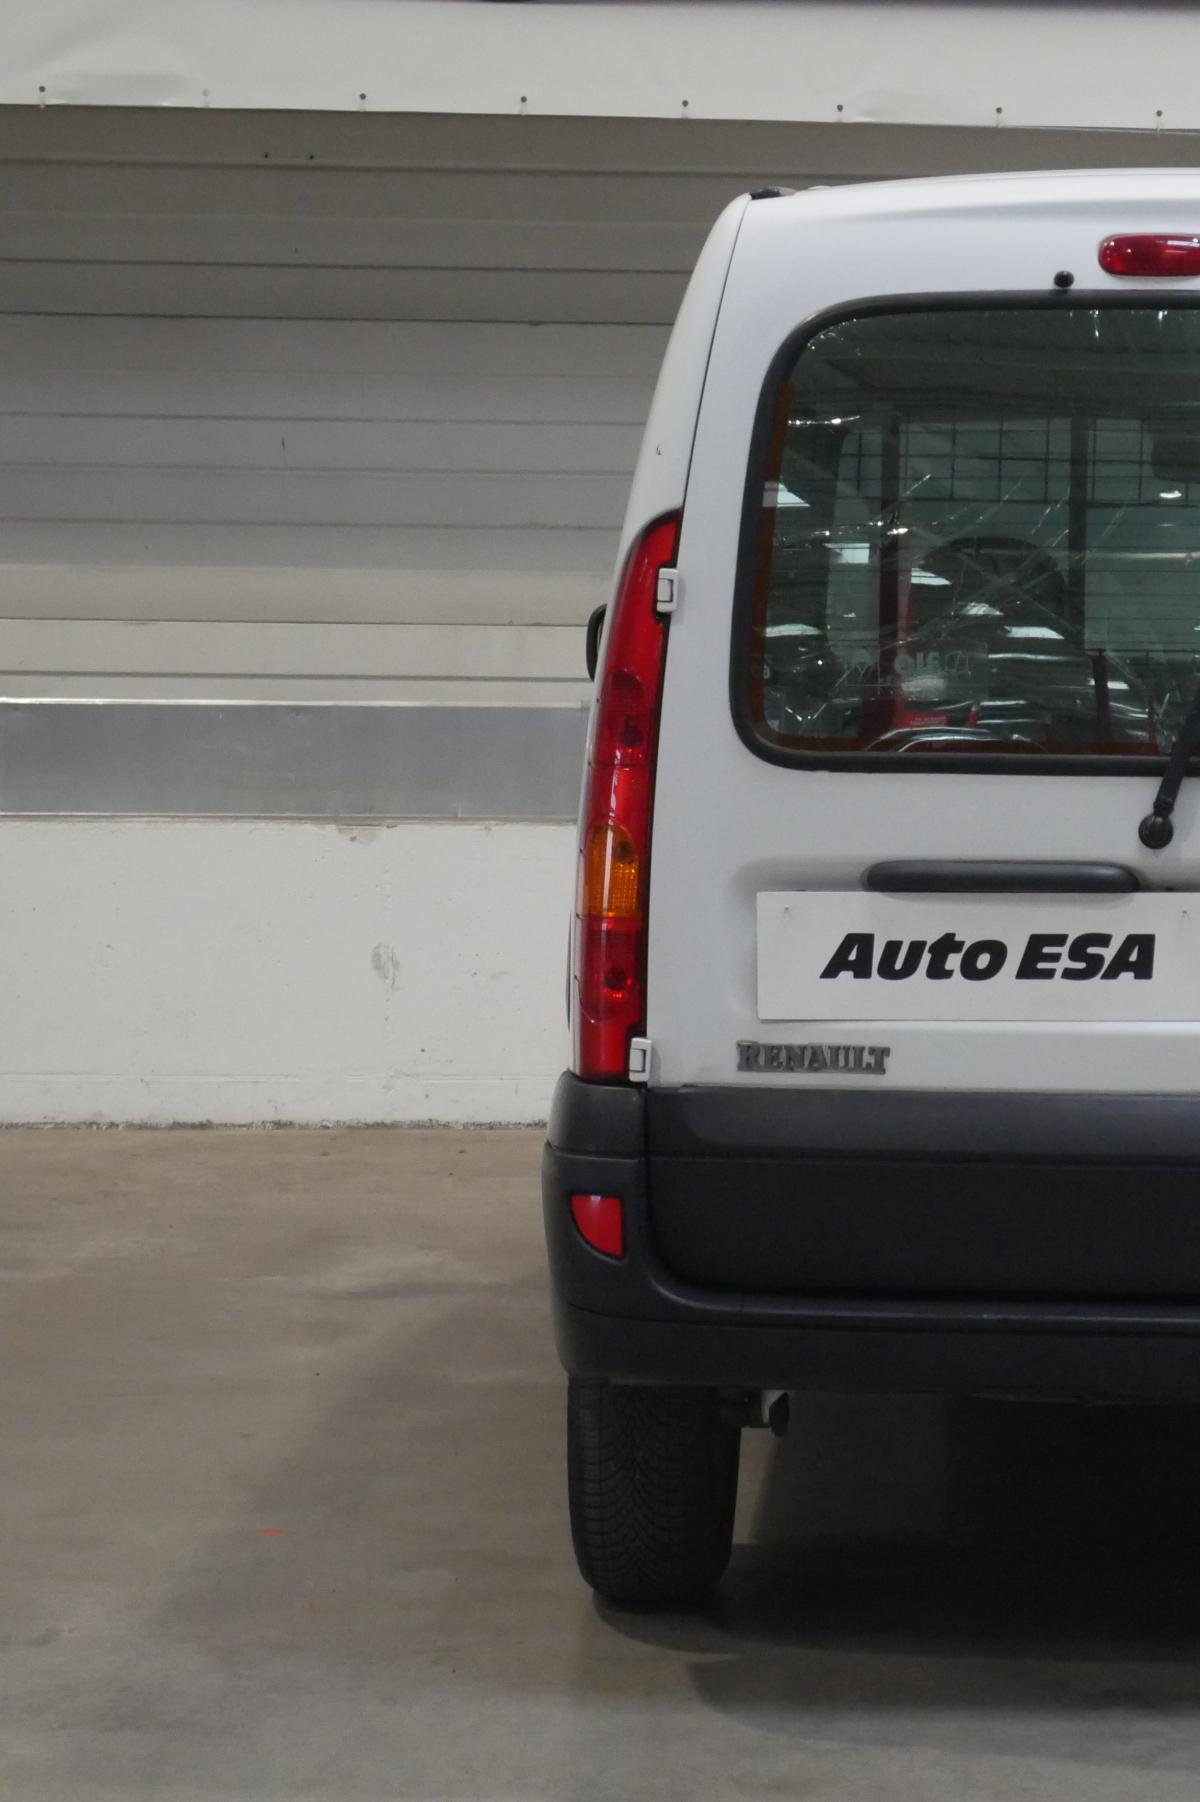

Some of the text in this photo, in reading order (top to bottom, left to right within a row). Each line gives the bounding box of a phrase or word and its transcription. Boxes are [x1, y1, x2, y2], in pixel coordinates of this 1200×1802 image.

[819, 932, 1156, 981] Auto ESA
[736, 1040, 890, 1075] RENAULT
